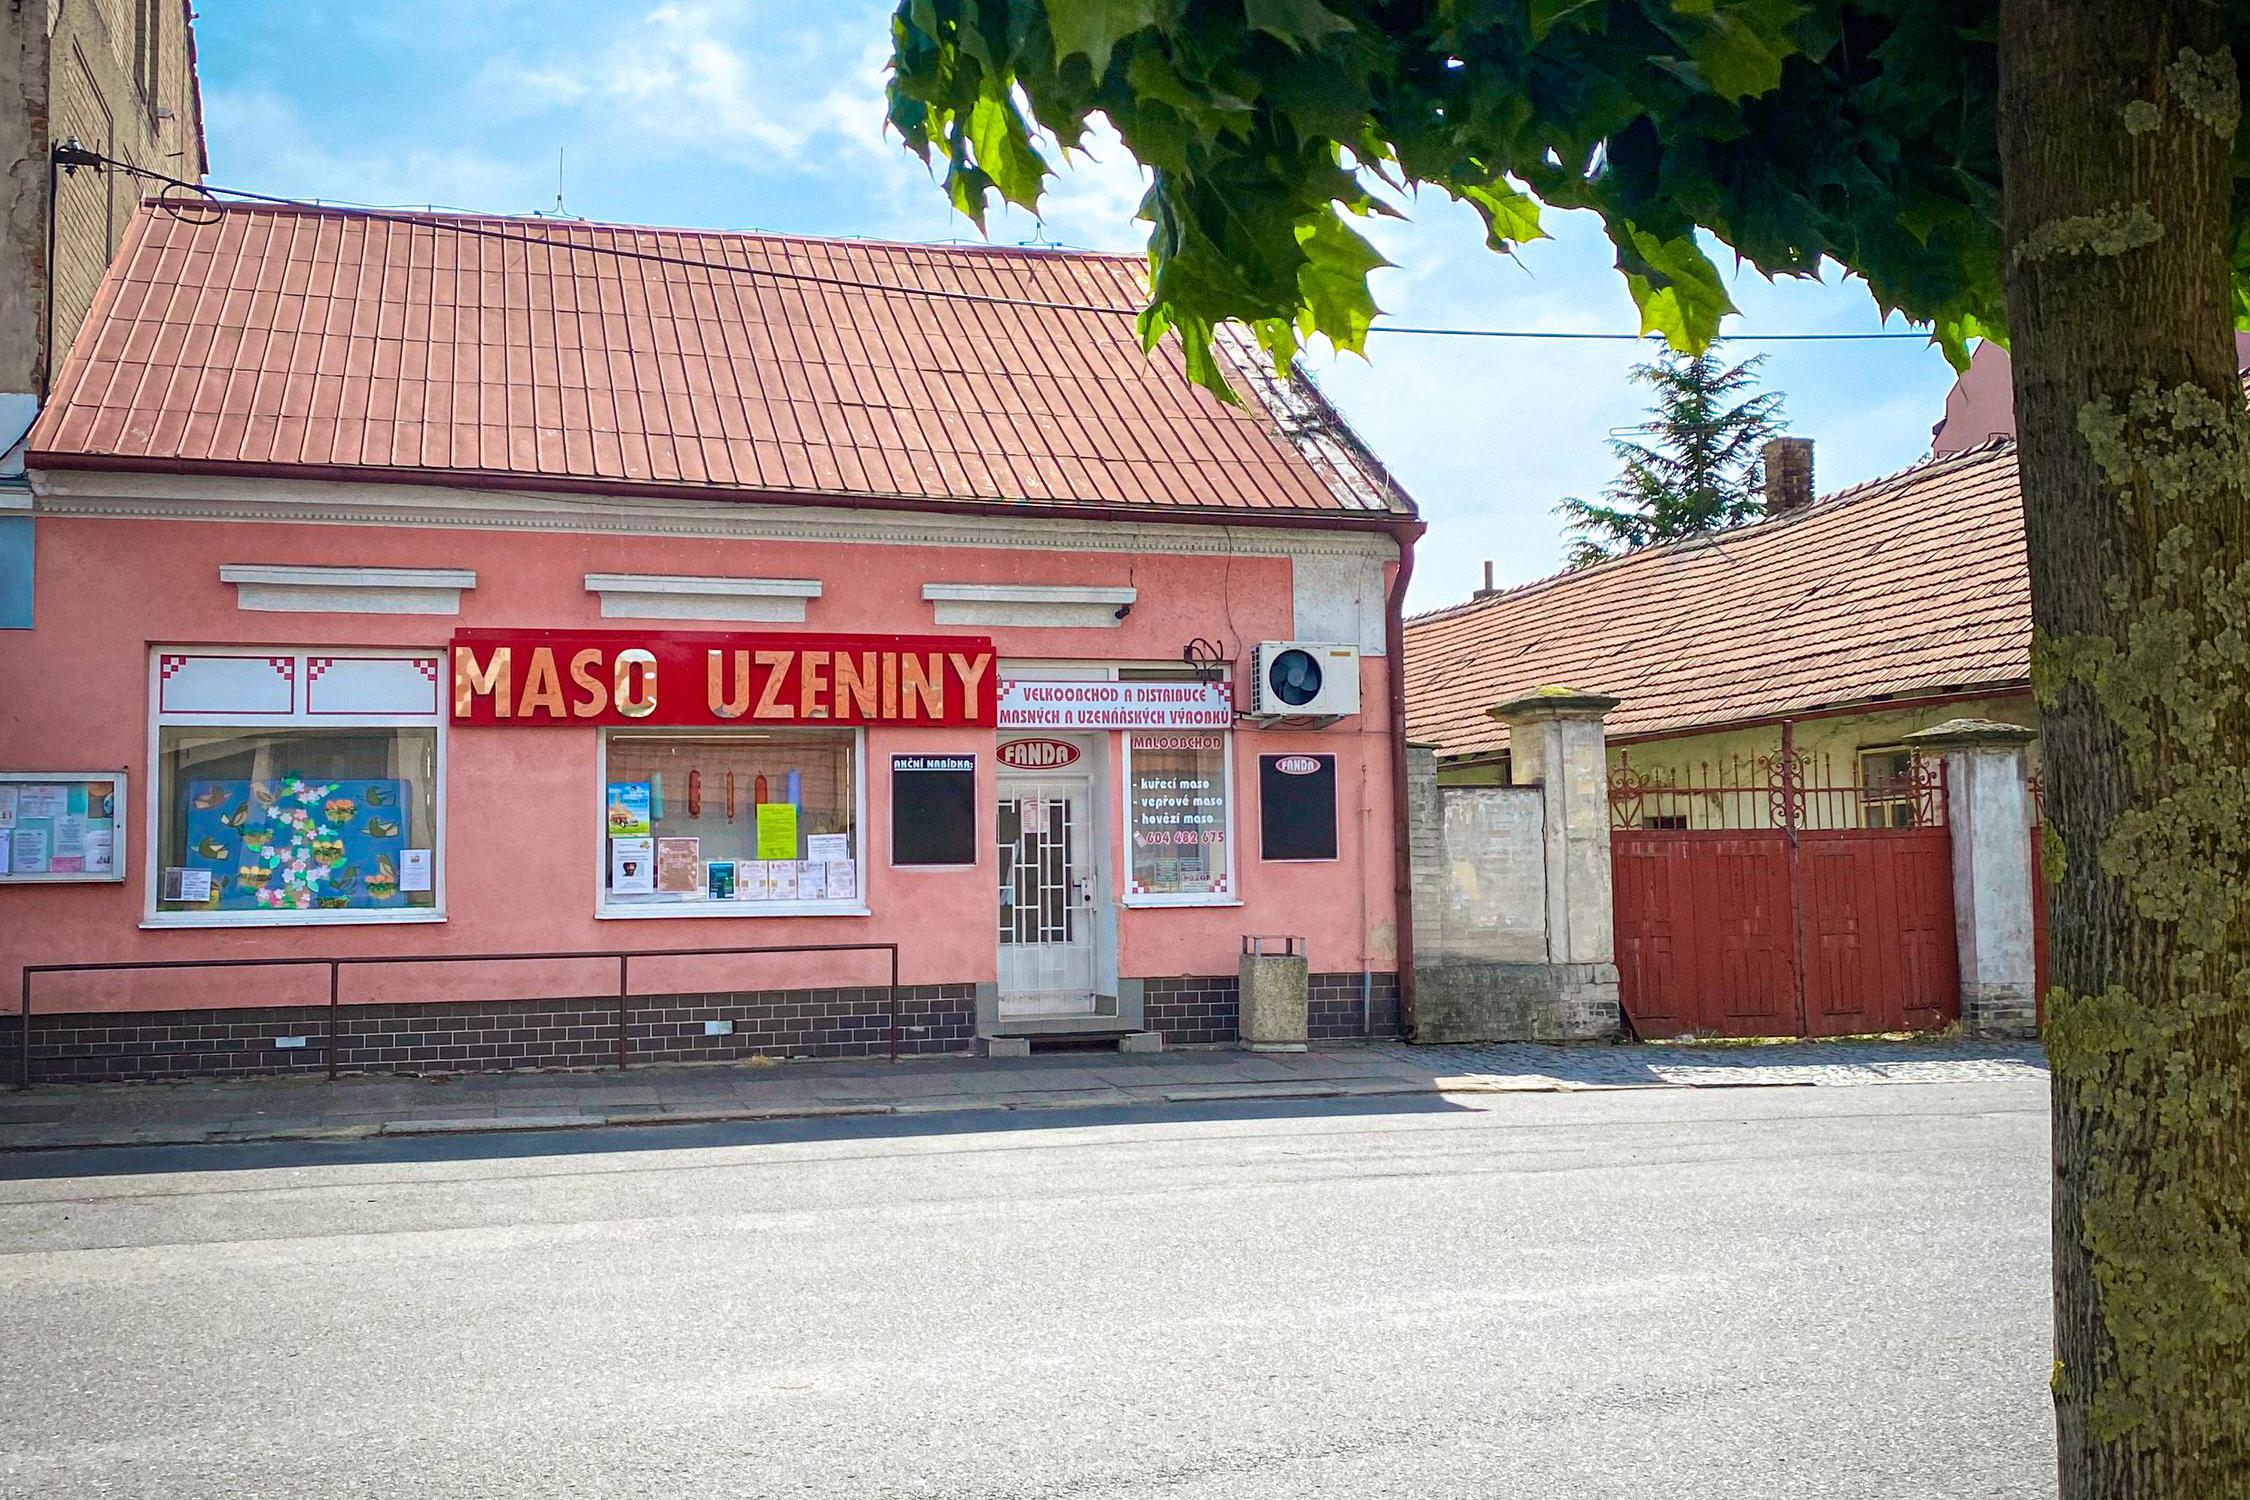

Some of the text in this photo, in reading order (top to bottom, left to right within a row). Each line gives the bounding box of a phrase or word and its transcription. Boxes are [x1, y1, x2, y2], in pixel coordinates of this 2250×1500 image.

[455, 646, 993, 720] MASO UZENINY
[1023, 687, 1206, 702] VELKOOBCHOD A DISTRIBUCE
[1000, 706, 1229, 724] MASNÝCH A UZENÁŘSKÝCH VÝROBKŮ
[1133, 736, 1222, 750] MALOOBCHOD
[1004, 742, 1069, 766] FANDA
[894, 757, 974, 769] AKČNÍ NABÍDKA:
[1281, 758, 1315, 771] FANDA
[1141, 777, 1177, 790] kuřecí
[1179, 779, 1210, 789] maso
[1141, 794, 1190, 809] vepřové
[1193, 797, 1223, 806] maso
[1141, 812, 1180, 824] hovězí
[1183, 814, 1214, 824] maso
[1146, 830, 1224, 844] 604 482 675
